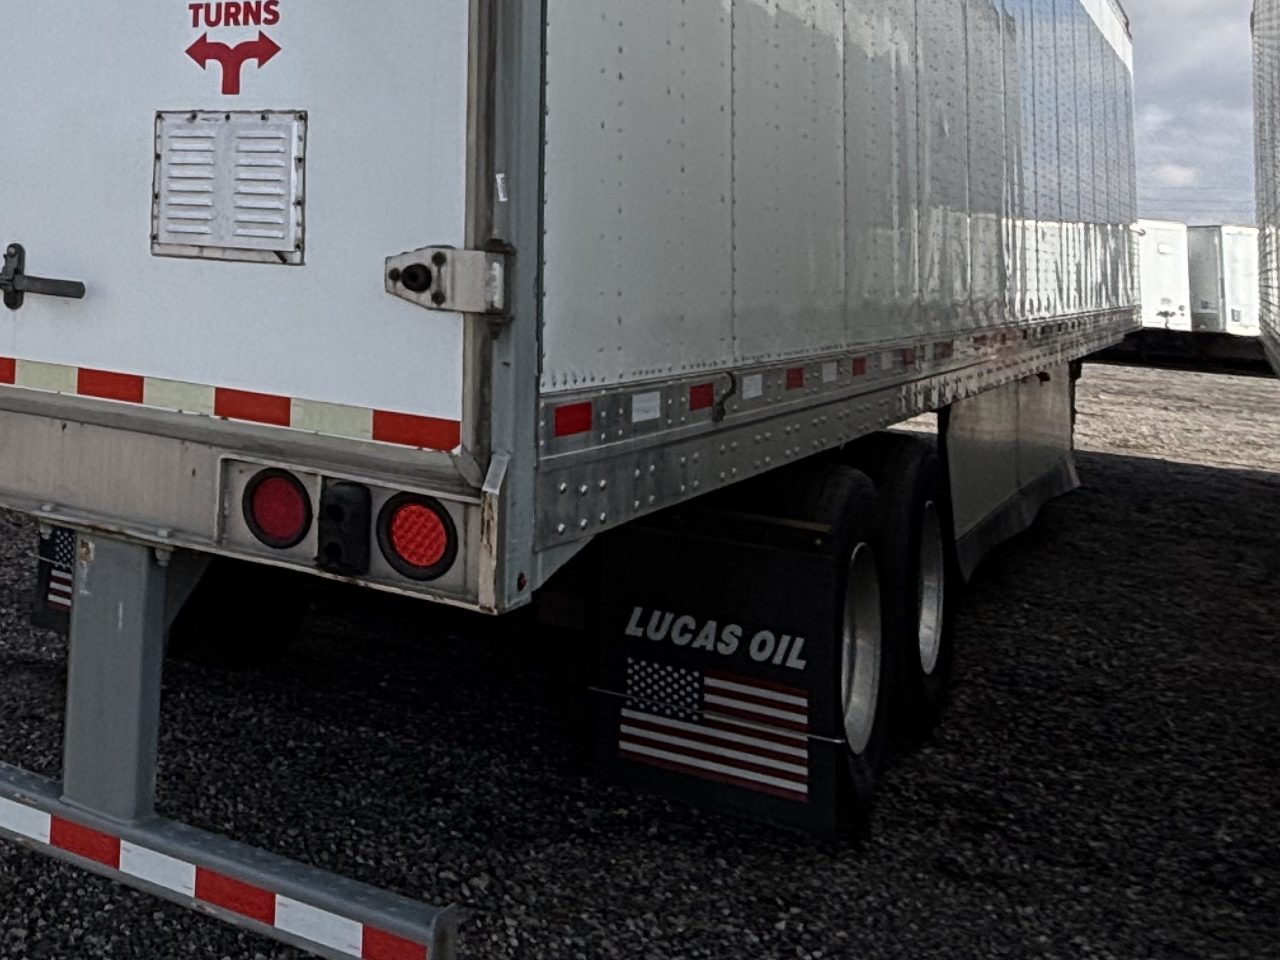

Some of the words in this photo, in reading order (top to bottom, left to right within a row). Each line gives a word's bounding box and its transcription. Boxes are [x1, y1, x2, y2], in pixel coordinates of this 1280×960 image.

[188, 0, 280, 28] TURNS
[625, 606, 743, 656] LUCAS
[749, 630, 807, 670] OIL
